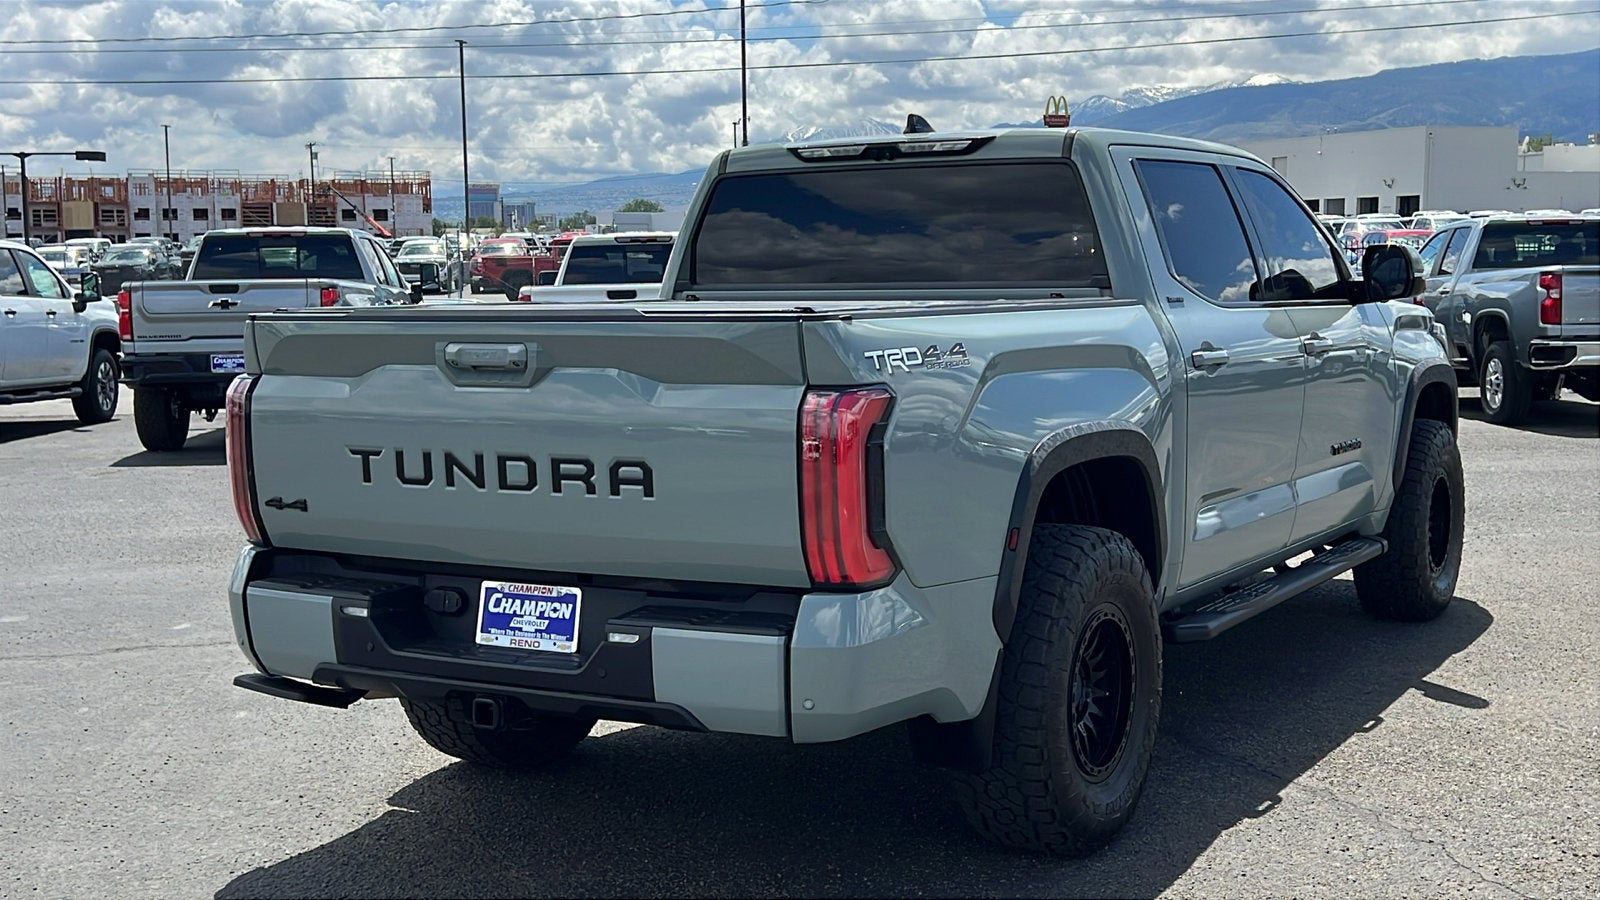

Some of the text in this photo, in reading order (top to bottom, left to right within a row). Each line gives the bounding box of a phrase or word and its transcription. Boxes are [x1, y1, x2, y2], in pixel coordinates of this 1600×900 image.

[864, 346, 922, 375] TRD
[345, 445, 655, 500] TUNDRA
[508, 584, 554, 595] CHAMPION
[488, 593, 573, 619] CHAMPION
[512, 619, 546, 627] CHEVROLET
[509, 638, 540, 649] RENO
